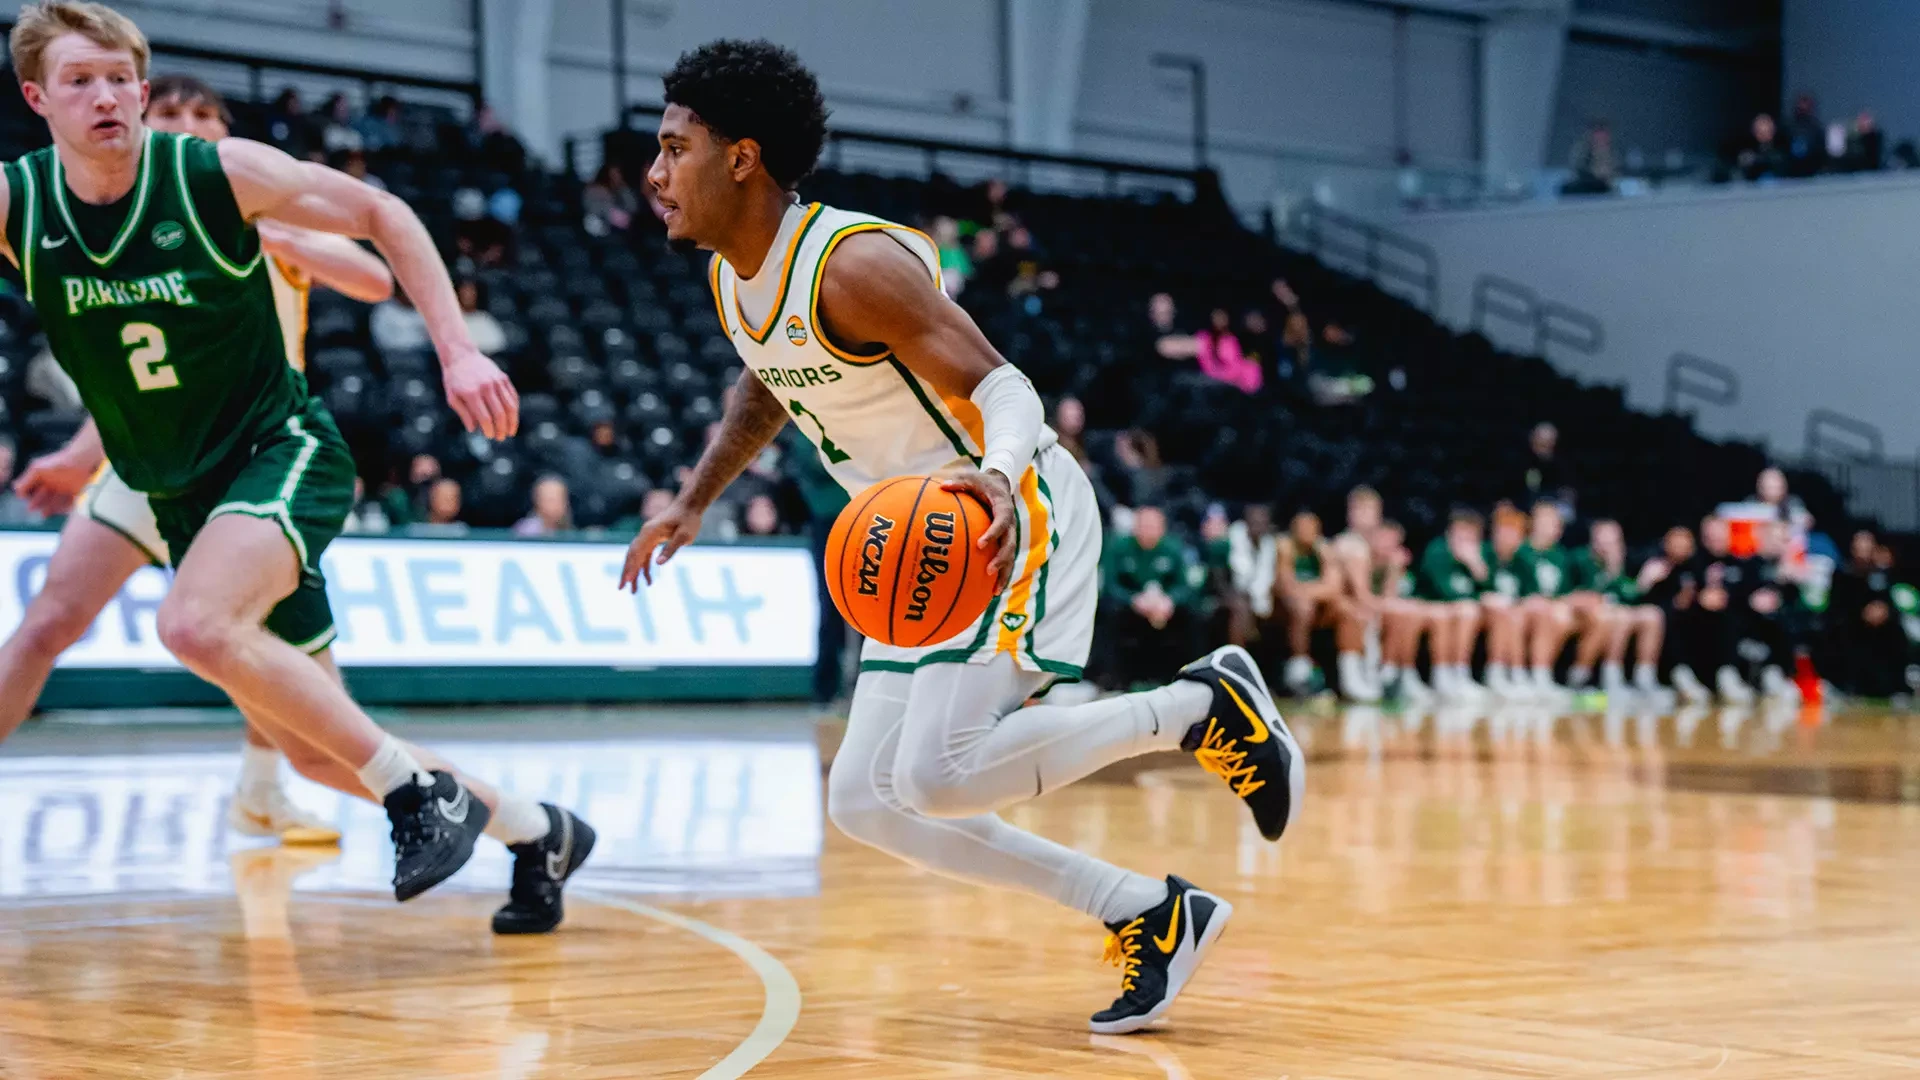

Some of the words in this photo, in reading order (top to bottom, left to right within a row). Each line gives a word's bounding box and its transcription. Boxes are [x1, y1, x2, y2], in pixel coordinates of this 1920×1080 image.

[120, 322, 180, 391] 2
[758, 364, 842, 388] RRIORS
[858, 513, 895, 596] NCAA
[904, 511, 956, 621] Wilson
[322, 557, 764, 645] HEALTH
